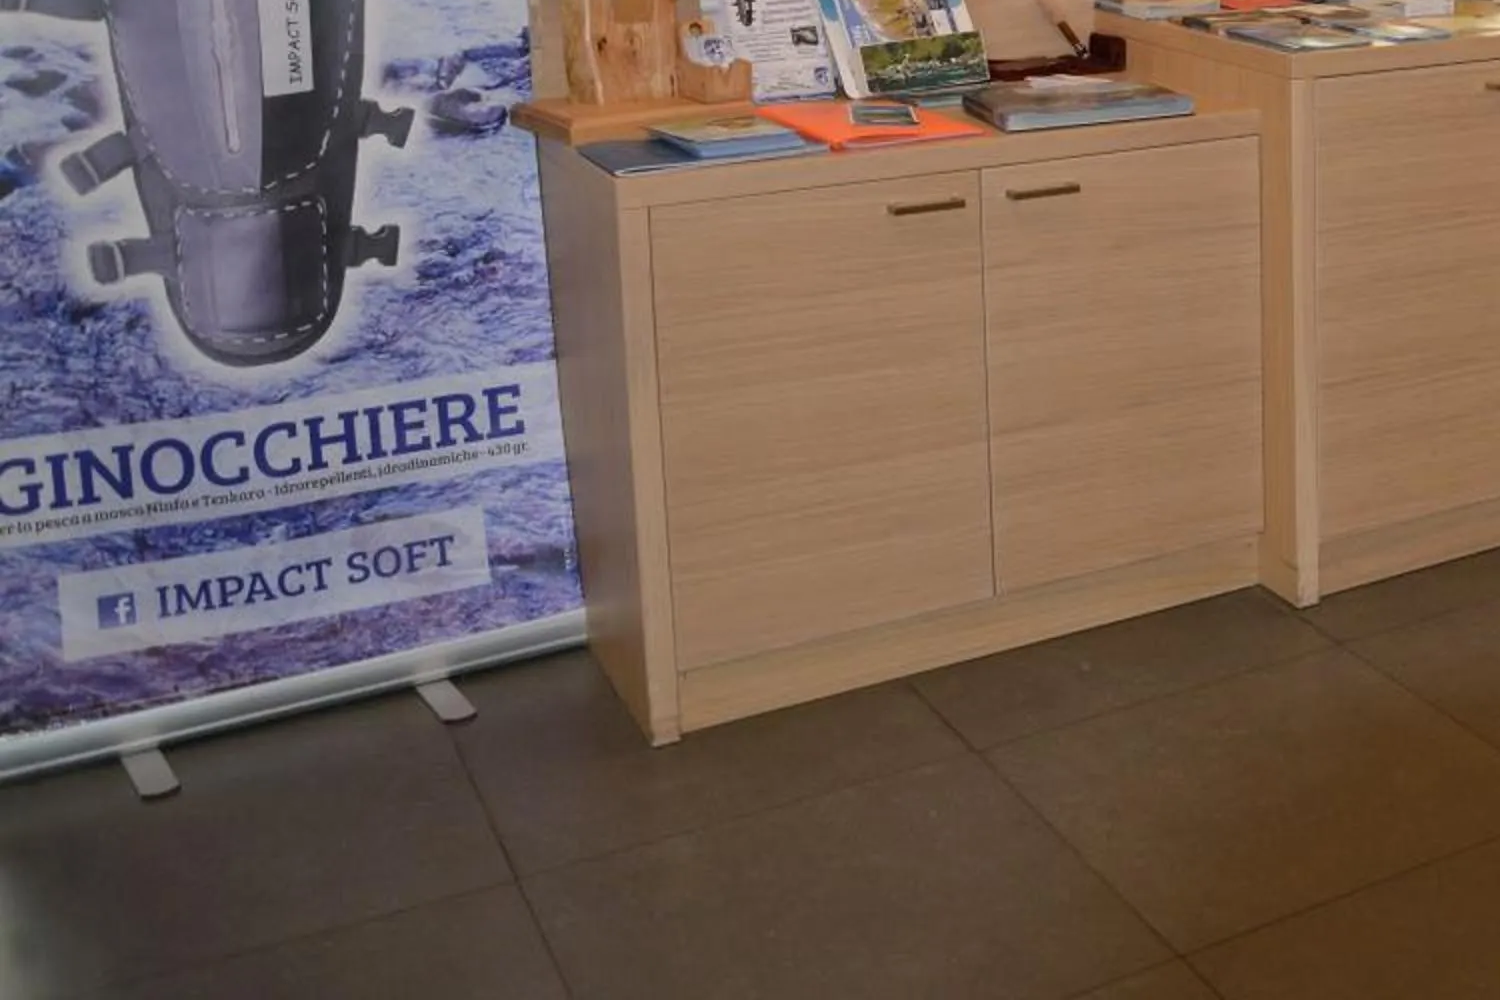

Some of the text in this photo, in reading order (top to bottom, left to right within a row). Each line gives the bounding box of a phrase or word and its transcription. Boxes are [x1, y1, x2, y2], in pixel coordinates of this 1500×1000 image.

[286, 16, 303, 84] IMPACT
[0, 383, 526, 516] GINOCCHIERE
[35, 514, 80, 537] pesca
[95, 505, 145, 522] mosca
[201, 489, 265, 508] Tenkara
[156, 558, 332, 618] IMPACT
[347, 535, 454, 584] SOFT
